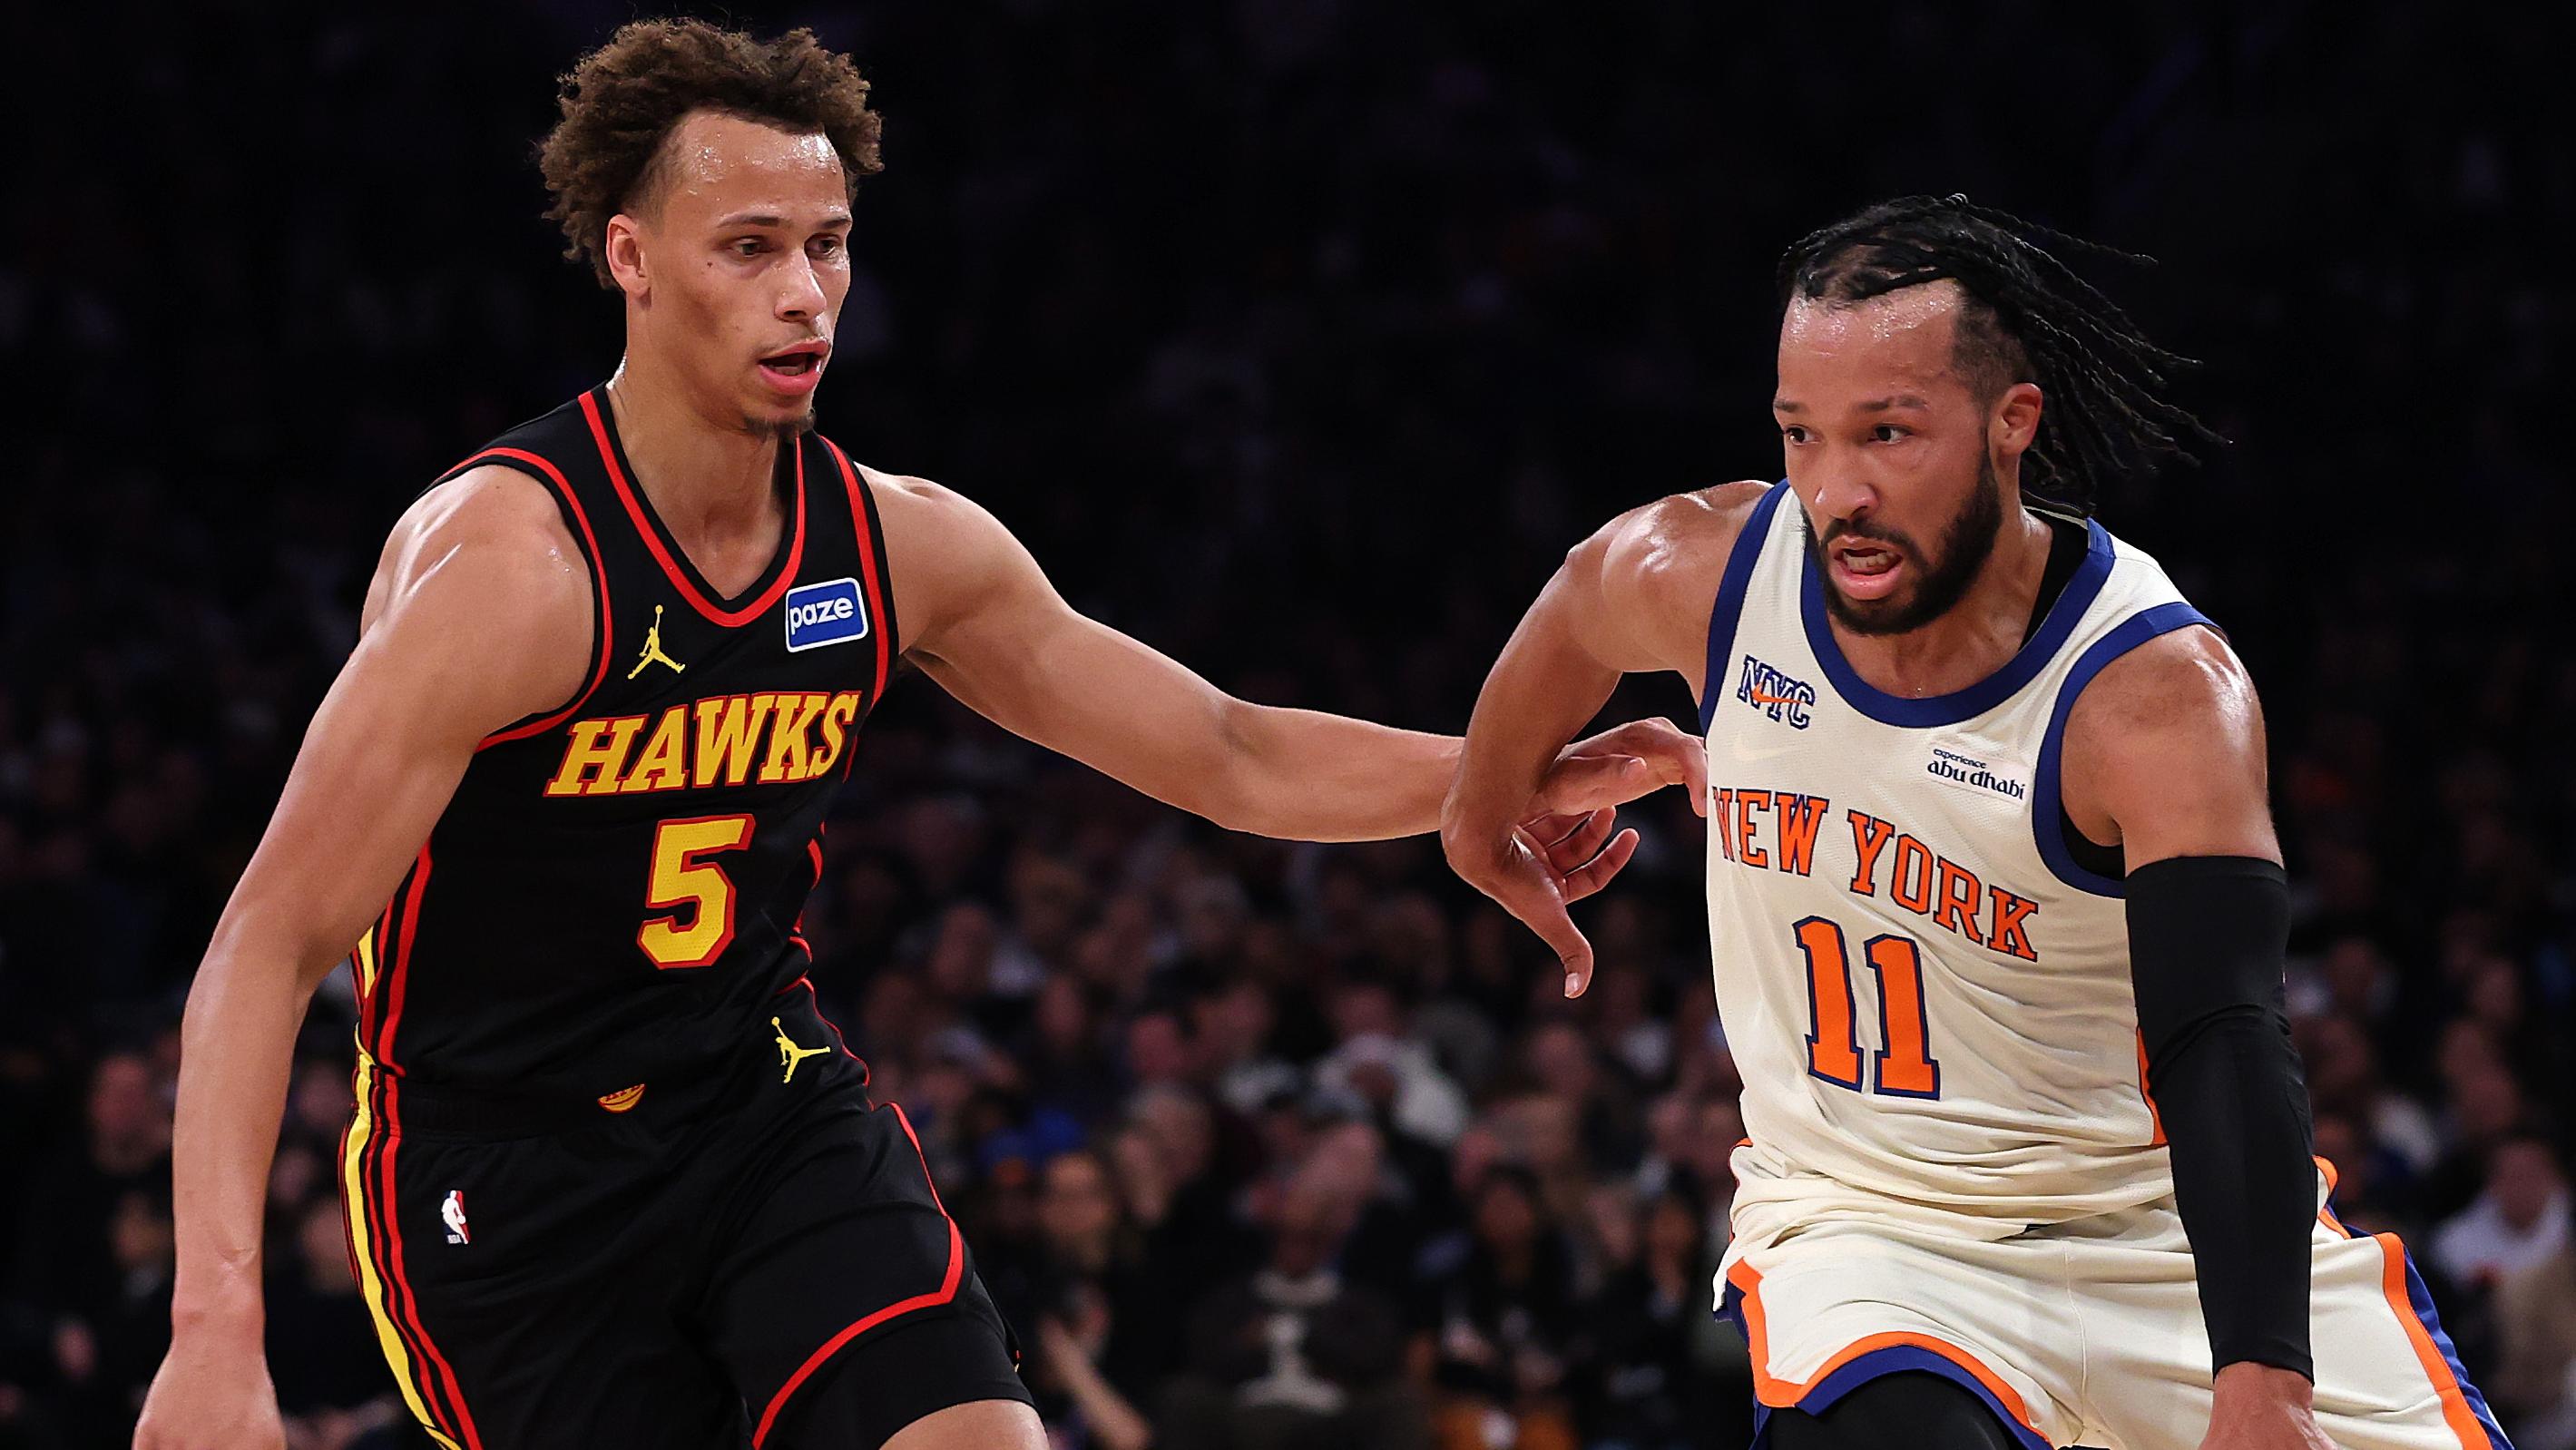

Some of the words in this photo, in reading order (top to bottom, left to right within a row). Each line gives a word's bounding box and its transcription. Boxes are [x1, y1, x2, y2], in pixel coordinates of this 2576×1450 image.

[789, 597, 854, 635] paze
[1736, 654, 1816, 730] NYC
[543, 691, 862, 797] HAWKS
[1927, 760, 1966, 783] abu
[1969, 770, 2025, 800] dhabi
[1933, 748, 1987, 769] experience
[637, 814, 755, 969] 5
[1846, 808, 2039, 962] YORK
[1792, 915, 1940, 1101] 11
